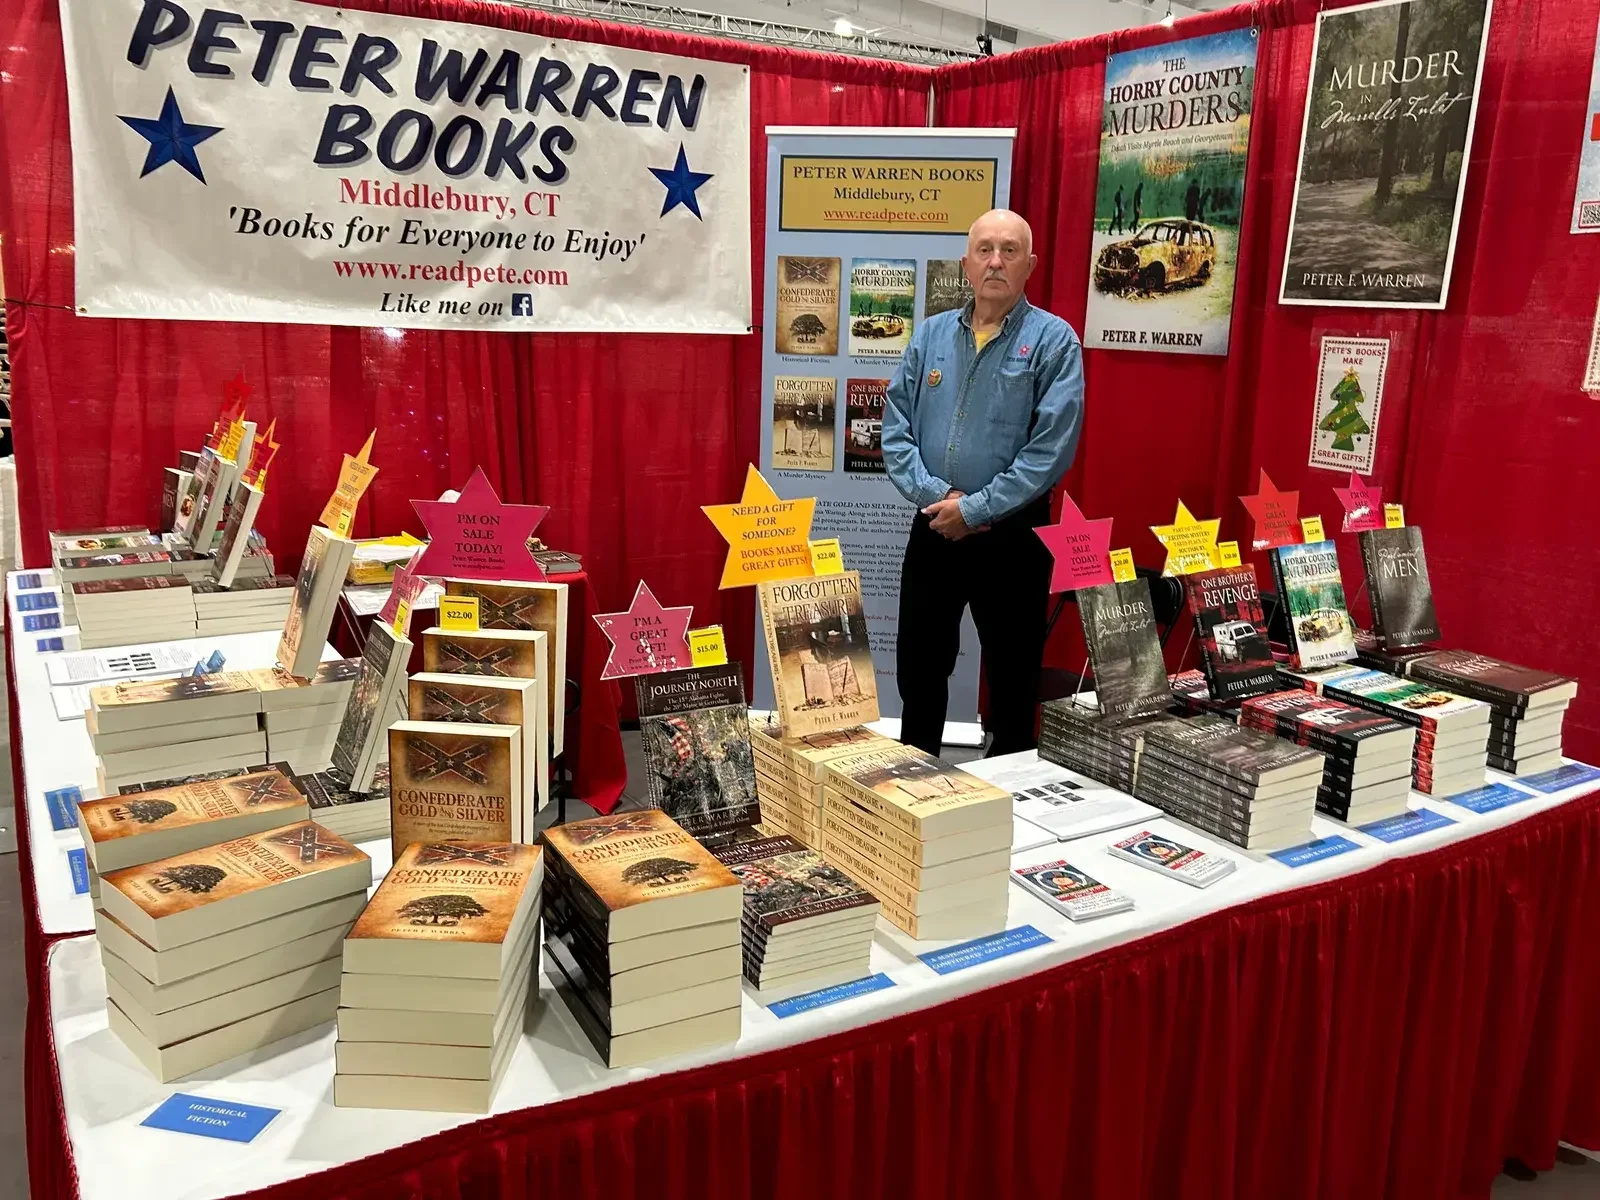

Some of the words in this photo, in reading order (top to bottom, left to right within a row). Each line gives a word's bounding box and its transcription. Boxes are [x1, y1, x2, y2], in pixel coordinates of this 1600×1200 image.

[126, 0, 400, 96] PETER
[413, 39, 706, 131] WARREN
[1163, 57, 1186, 73] THE
[1329, 49, 1464, 92] MURDER
[1109, 79, 1165, 105] HORRY
[1169, 65, 1246, 96] COUNTY
[1360, 94, 1372, 104] IN
[1108, 90, 1242, 137] MURDERS
[1402, 92, 1473, 122] Inlet
[313, 104, 577, 185] BOOKS
[1143, 139, 1161, 150] Myrtle
[1162, 137, 1180, 147] Beach
[1181, 135, 1194, 145] and
[1195, 132, 1233, 145] Georgetown
[793, 166, 847, 179] PETER
[852, 167, 923, 181] WARREN
[928, 169, 984, 182] BOOKS
[339, 178, 517, 219] Middlebury,
[524, 190, 561, 218] CT
[834, 187, 915, 203] Middlebury,
[919, 189, 941, 200] CT
[824, 208, 949, 223] www.readpete.com
[229, 205, 335, 242] 'Books
[340, 218, 391, 249] for
[400, 220, 527, 254] Everyone
[532, 231, 556, 251] to
[562, 228, 646, 262] Enjoy'
[333, 257, 569, 288] www.readpete.com
[855, 268, 880, 276] HORRY
[882, 269, 912, 278] COUNTY
[855, 276, 912, 287] MURDERS
[1302, 273, 1344, 287] PETER
[1349, 274, 1357, 287] F.
[1362, 273, 1426, 289] WARREN
[780, 288, 836, 297] CONFEDERATE
[379, 291, 431, 315] Like
[438, 298, 473, 316] me
[479, 298, 504, 317] on
[779, 296, 800, 304] GOLD
[808, 297, 836, 305] SILVER
[1101, 329, 1137, 344] PETER
[1139, 331, 1148, 344] F.
[1151, 331, 1203, 346] WARREN
[1327, 346, 1351, 355] PETE'S
[1355, 348, 1382, 357] BOOKS
[1342, 357, 1363, 366] MAKE
[777, 380, 833, 391] FORGOTTEN
[781, 392, 829, 403] TREASURE
[1317, 450, 1340, 461] GREAT
[1341, 452, 1366, 463] GIFTS!
[805, 473, 827, 481] Mystery
[732, 506, 760, 516] NEED
[762, 504, 769, 513] A
[771, 502, 795, 513] GIFT
[872, 502, 896, 510] SILVER
[457, 514, 476, 524] I'M
[480, 515, 500, 526] ON
[756, 517, 777, 526] FOR
[881, 512, 899, 520] Bobby
[463, 529, 494, 540] SALE
[742, 528, 796, 541] SOMEONE?
[1078, 533, 1091, 543] ON
[455, 543, 503, 554] TODAY!
[741, 547, 774, 558] BOOKS
[776, 544, 804, 555] MAKE
[817, 552, 836, 560] $22.00
[1072, 544, 1091, 554] SALE
[742, 561, 775, 572] GREAT
[777, 557, 808, 568] GIFTS!
[1070, 554, 1098, 565] TODAY!
[1284, 555, 1308, 565] HORRY
[1308, 551, 1335, 563] COUNTY
[1286, 562, 1338, 579] MURDERS
[1383, 559, 1420, 579] MEN
[1201, 578, 1217, 589] ONE
[1219, 571, 1254, 586] BROTHER'S
[772, 576, 858, 604] FORGOTTEN
[1203, 584, 1257, 608] REVENGE
[447, 611, 473, 620] $22.00
[782, 599, 853, 623] TREASURE
[1095, 602, 1148, 622] MURDER
[634, 617, 652, 627] I'M
[654, 615, 662, 625] A
[630, 628, 668, 640] GREAT
[696, 643, 719, 653] $15.00
[1329, 650, 1348, 660] WARREN
[686, 673, 701, 681] THE
[1227, 680, 1244, 692] PETER
[1245, 680, 1250, 688] F.
[1250, 674, 1274, 686] WARREN
[651, 681, 697, 699] JOURNEY
[699, 675, 738, 690] NORTH
[1115, 702, 1132, 712] PETER
[1138, 695, 1166, 708] WARREN
[814, 714, 831, 726] PETER
[839, 711, 859, 722] WARREN
[828, 772, 857, 796] FORGOTTEN
[856, 786, 880, 811] TREASURE
[398, 790, 505, 810] CONFEDERATE
[398, 804, 437, 818] GOLD
[457, 808, 505, 823] SILVER
[706, 811, 748, 823] WARREN
[827, 797, 857, 821] FORGOTTEN
[856, 813, 880, 837] TREASURE
[572, 831, 681, 858] CONFEDERATE
[826, 818, 856, 841] FORGOTTEN
[855, 834, 878, 858] TREASURE
[577, 850, 620, 864] GOLD
[640, 837, 690, 853] SILVER
[751, 839, 793, 853] NORTH
[221, 843, 247, 858] GOLD
[253, 861, 284, 882] SILVER
[236, 838, 301, 878] CONFEDERATE
[825, 839, 853, 865] FORGOTTEN
[853, 857, 875, 881] TREASURE
[391, 876, 438, 885] GOLD
[461, 878, 521, 887] SILVER
[395, 869, 524, 880] CONFEDERATE
[189, 1103, 247, 1118] HISTORICAL
[186, 1114, 230, 1127] FICTION
